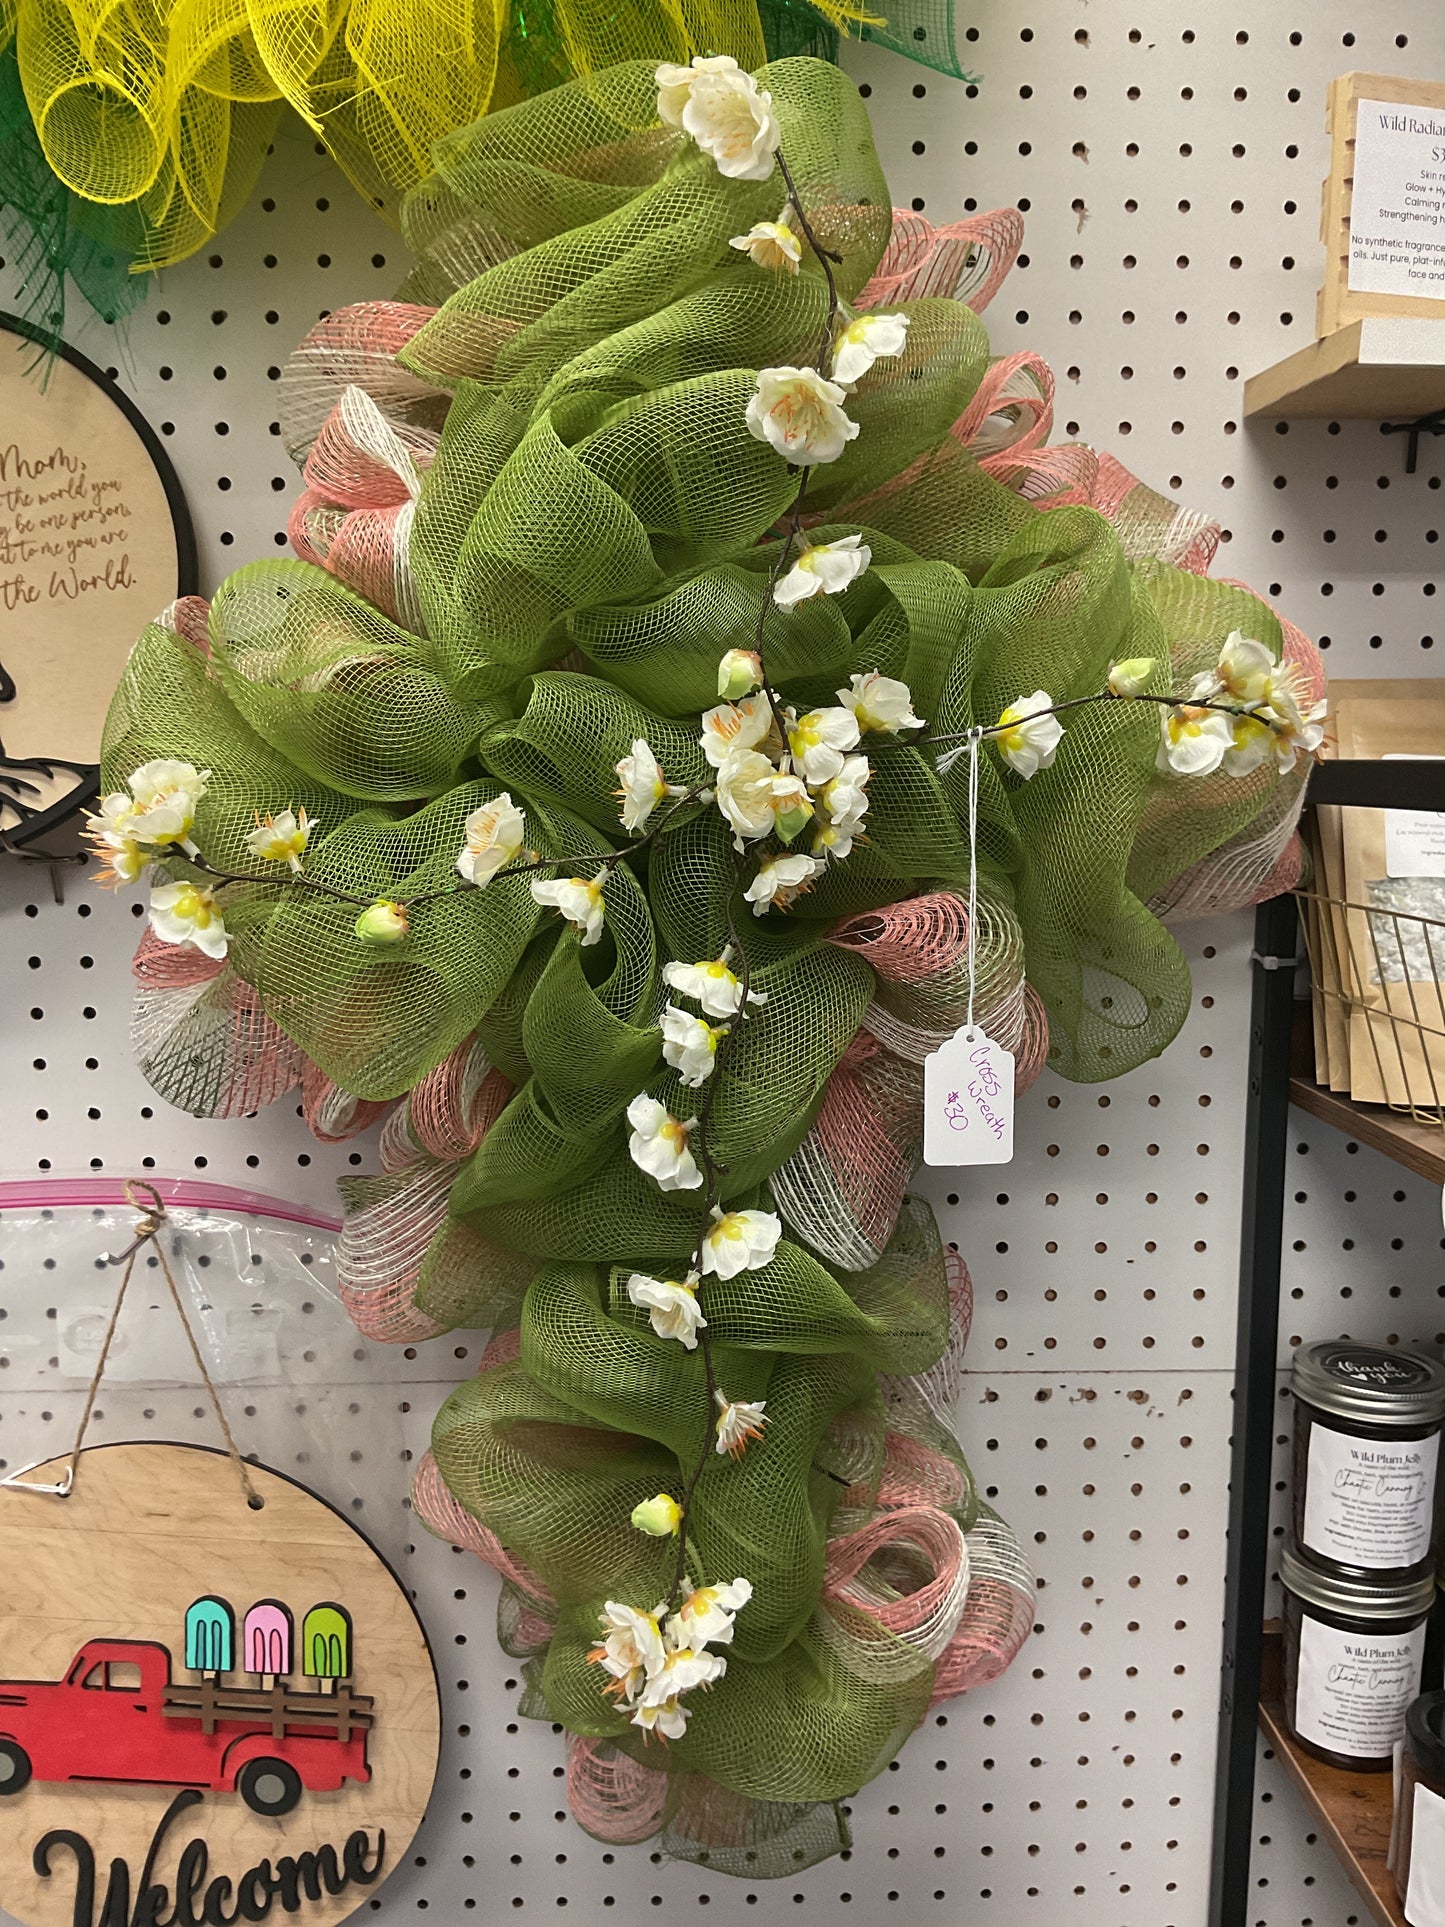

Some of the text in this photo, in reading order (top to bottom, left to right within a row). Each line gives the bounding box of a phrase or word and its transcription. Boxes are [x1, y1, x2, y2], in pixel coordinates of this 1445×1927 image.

[1379, 115, 1406, 132] Wild
[1420, 170, 1437, 180] Skin
[1405, 183, 1426, 192] Glow
[1405, 197, 1440, 211] Calming
[1379, 209, 1438, 225] Strengthening
[1352, 235, 1363, 244] No
[1365, 238, 1403, 248] synthetic
[1353, 250, 1369, 259] oils.
[1371, 252, 1388, 261] Just
[1390, 255, 1410, 265] pure,
[1408, 269, 1427, 278] face
[6, 473, 122, 511] the world you
[16, 512, 35, 534] be
[40, 513, 68, 529] one
[41, 542, 64, 557] me
[67, 538, 97, 564] you
[100, 529, 128, 545] are
[0, 554, 137, 610] the World.
[943, 1091, 969, 1131] $30
[1338, 1361, 1401, 1373] thank
[1370, 1372, 1414, 1384] you
[1351, 1449, 1374, 1462] Wild
[1376, 1454, 1402, 1464] Plum
[1344, 1645, 1367, 1657] Wild
[1370, 1649, 1394, 1658] Plum
[33, 1789, 385, 1927] Welcome
